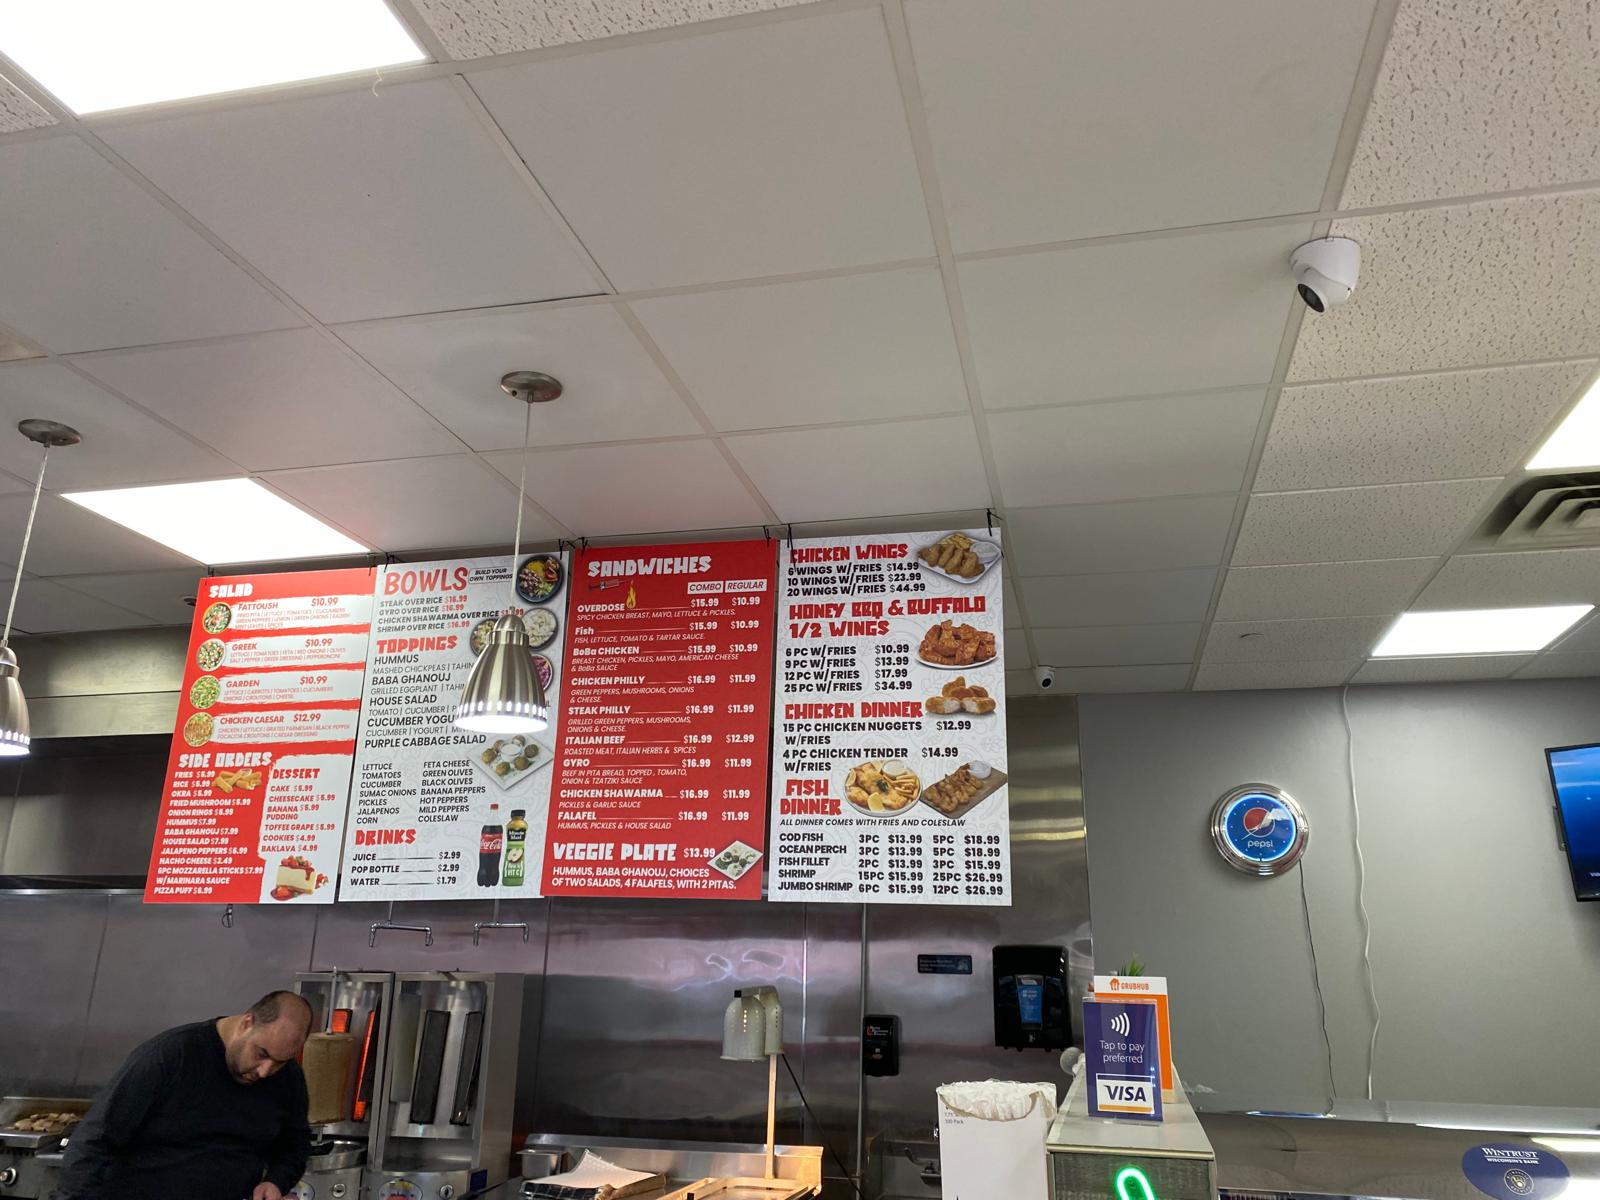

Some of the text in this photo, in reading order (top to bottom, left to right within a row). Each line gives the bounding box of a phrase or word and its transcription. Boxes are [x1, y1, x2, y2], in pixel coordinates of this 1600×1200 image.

[791, 544, 908, 564] CHICKEN WINGS
[588, 556, 712, 577] SANDWICHES
[384, 567, 468, 595] BOWLS
[788, 578, 798, 586] 10
[801, 576, 836, 585] WINGS
[889, 573, 921, 582] $23.99
[209, 583, 253, 598] SALAD
[689, 581, 764, 592] COMBO REGULAR
[238, 597, 338, 610] FATTOUSH $10.99
[405, 598, 425, 606] OVER
[578, 597, 760, 612] OVERDOSE $15.99 $10.99
[790, 596, 985, 620] HONEY BBQ & BUFFALO
[379, 610, 498, 624] CHICKEN SHAWARMA OVER RICE
[652, 611, 673, 619] MAYO,
[575, 620, 759, 635] Fish $15.99 $10.99
[790, 621, 889, 638] 1/2 WINGS
[232, 638, 333, 651] GREEK $10.99
[376, 636, 458, 654] TOPPINGS
[598, 646, 639, 655] CHICKEN
[688, 645, 716, 654] $15.99
[730, 644, 758, 652] $10.99
[375, 655, 419, 665] HUMMUS
[373, 664, 445, 674] MASHED CHICKPEAS
[226, 676, 327, 688] GARDEN $10.99
[785, 701, 923, 719] CHICKEN DINNER
[220, 713, 321, 725] CHICKEN CAESAR $12.99
[783, 721, 971, 732] 15 PC CHICKEN NUGGETS $12.99
[365, 735, 486, 749] PURPLE CABBAGE SALAD
[565, 734, 754, 745] ITALIAN BEEF $16.99 $12.99
[786, 735, 830, 746] W/FRIES
[178, 752, 272, 768] SIDE ORDERS
[273, 768, 320, 779] DESSERT
[786, 779, 828, 796] FISH
[360, 790, 386, 798] SUMAC
[780, 799, 841, 816] DINNER
[418, 815, 458, 823] COLESLAW
[922, 819, 965, 827] COLESLAW
[355, 829, 416, 846] DRINKS
[780, 833, 999, 845] COD FISH 3PC $13.99 5PC $18.99
[1248, 840, 1273, 848] pepsi
[439, 852, 460, 860] $2.99
[553, 842, 715, 861] VEGGIE PLATE $13.99
[553, 867, 709, 877] HUMMUS, BABA GHANOUJ, CHOICES
[350, 877, 456, 886] WATER $1.79
[552, 878, 564, 887] OF
[565, 878, 585, 887] TWO
[587, 878, 623, 888] SALADS,
[632, 879, 675, 889] FALAFELS,
[677, 879, 700, 888] WITH
[708, 880, 736, 889] PITAS.
[778, 882, 1003, 895] JUMBO SHRIMP 6PC $15.99 12PC $26.99
[1121, 982, 1149, 990] GRUBHUB
[1099, 1040, 1144, 1053] Tap to pay
[1103, 1053, 1143, 1063] preferred
[1104, 1085, 1147, 1101] VISA
[1482, 1147, 1537, 1157] WINTRUST
